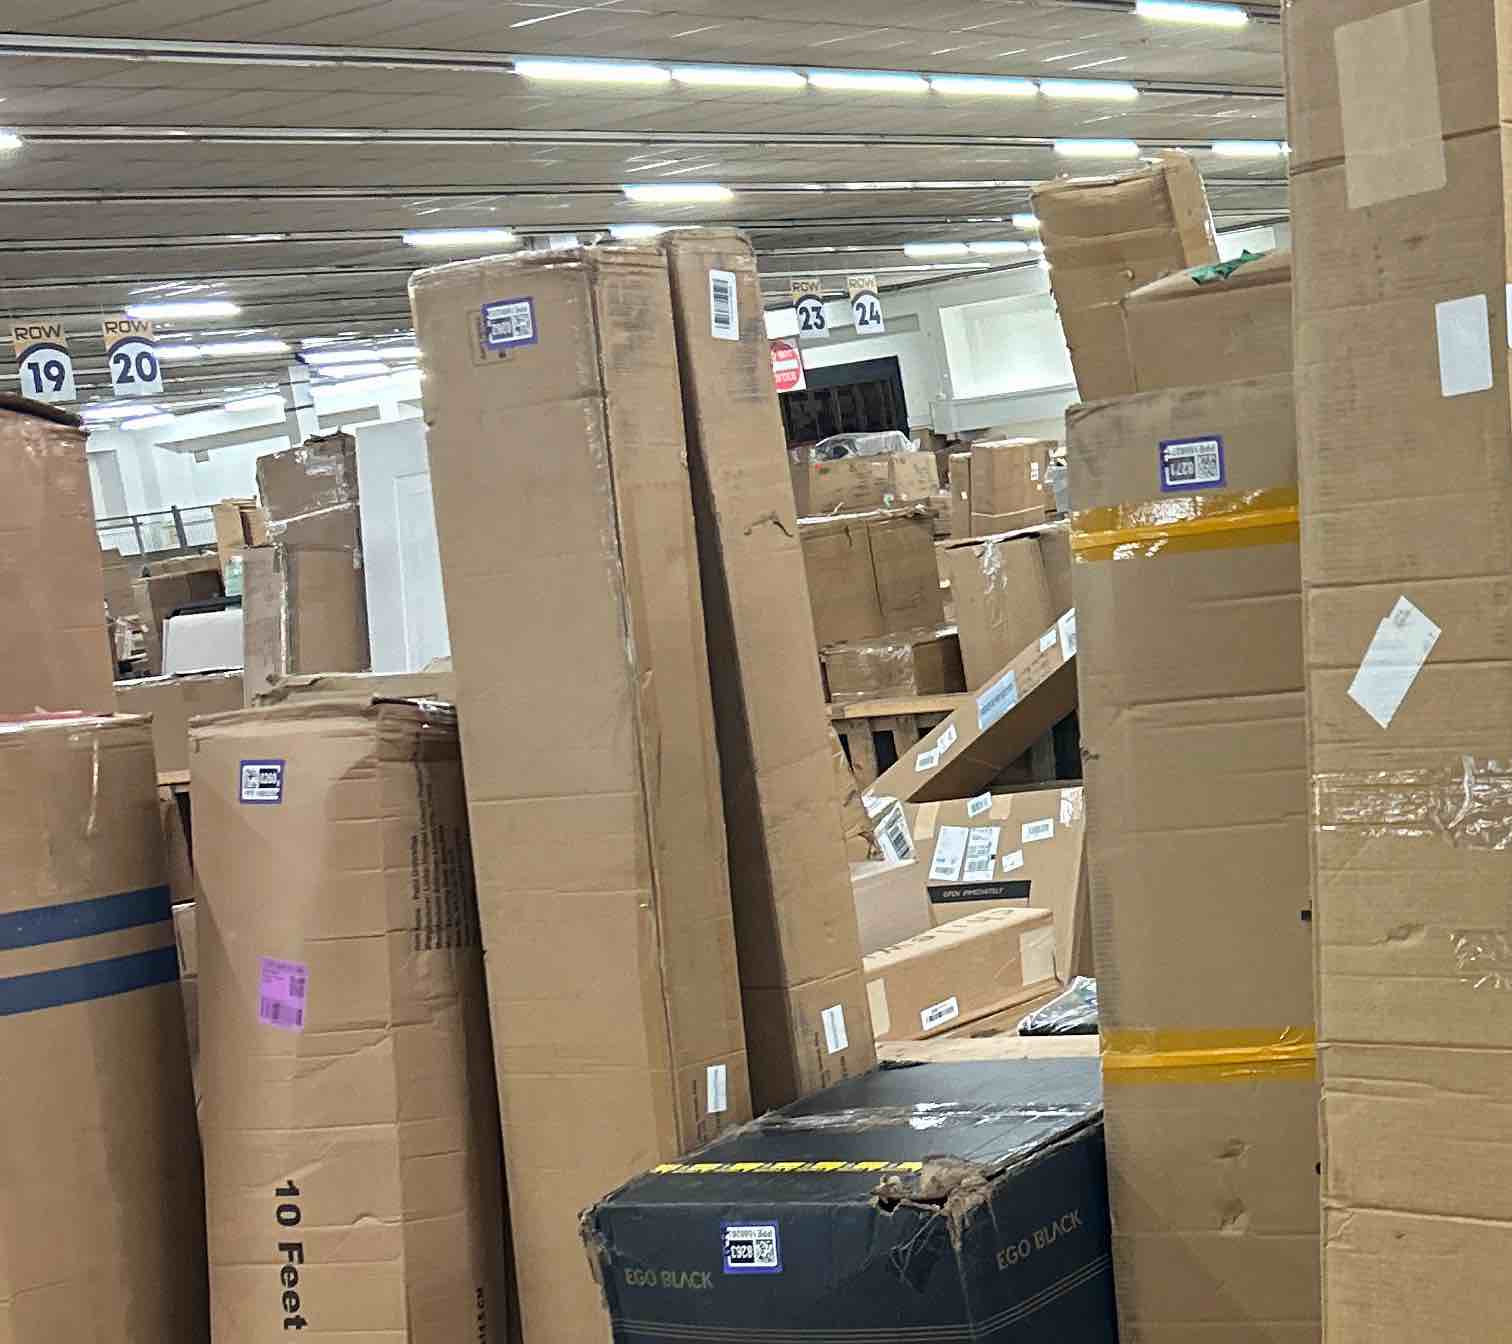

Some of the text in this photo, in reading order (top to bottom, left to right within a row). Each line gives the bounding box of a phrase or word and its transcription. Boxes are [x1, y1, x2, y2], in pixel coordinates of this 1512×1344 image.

[104, 319, 150, 335] ROW
[799, 306, 825, 330] 23
[855, 302, 881, 325] 24
[14, 323, 62, 341] ROW
[27, 359, 66, 394] 19
[113, 350, 158, 385] 20
[274, 1179, 301, 1227] 10
[996, 1209, 1085, 1271] EGO BLACK
[276, 1241, 308, 1331] Feet
[624, 1267, 714, 1289] EGO BLACK
